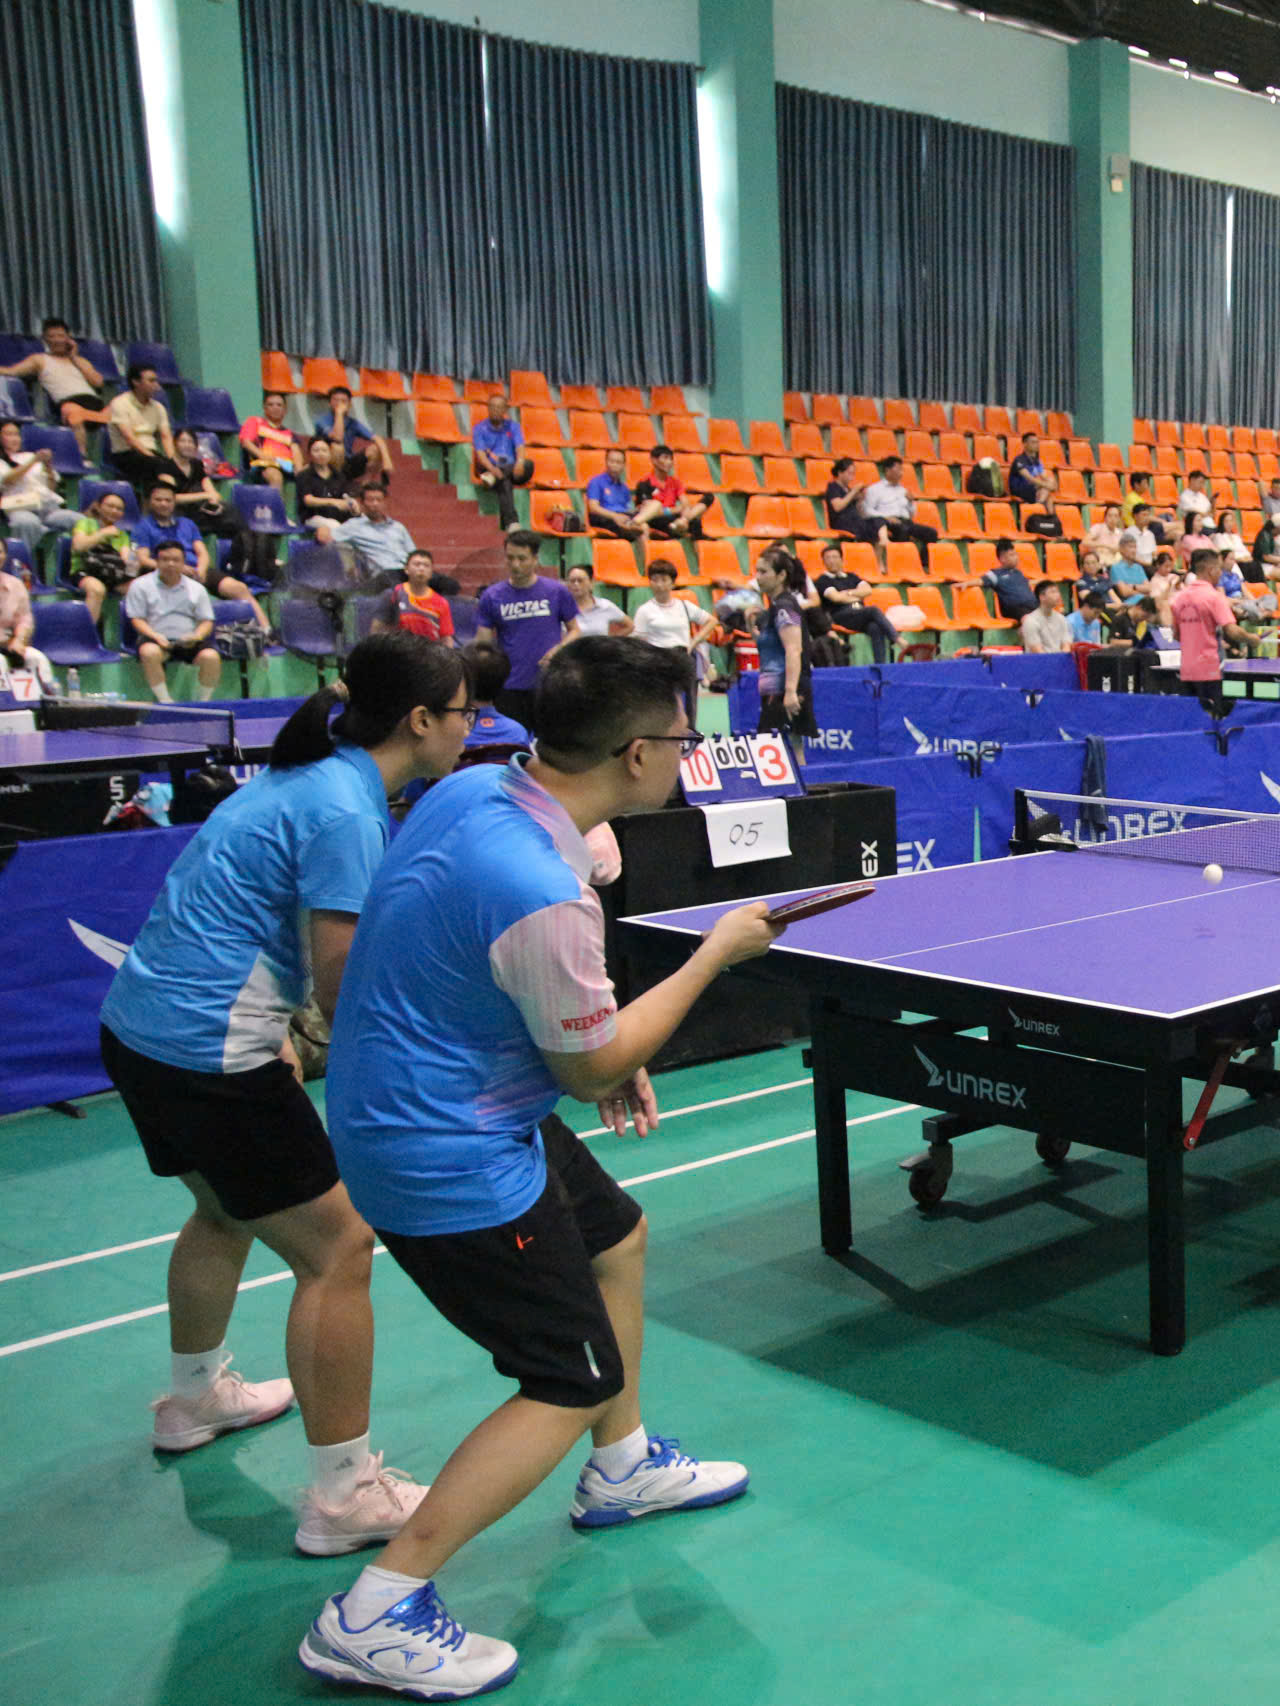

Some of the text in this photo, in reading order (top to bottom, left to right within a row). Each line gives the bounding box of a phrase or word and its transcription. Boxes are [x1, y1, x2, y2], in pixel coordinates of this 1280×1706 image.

[500, 599, 550, 617] VICTAS
[758, 744, 788, 781] 3
[729, 822, 763, 847] 05
[1023, 1018, 1061, 1037] UNREX
[947, 1070, 1027, 1110] UNREX
